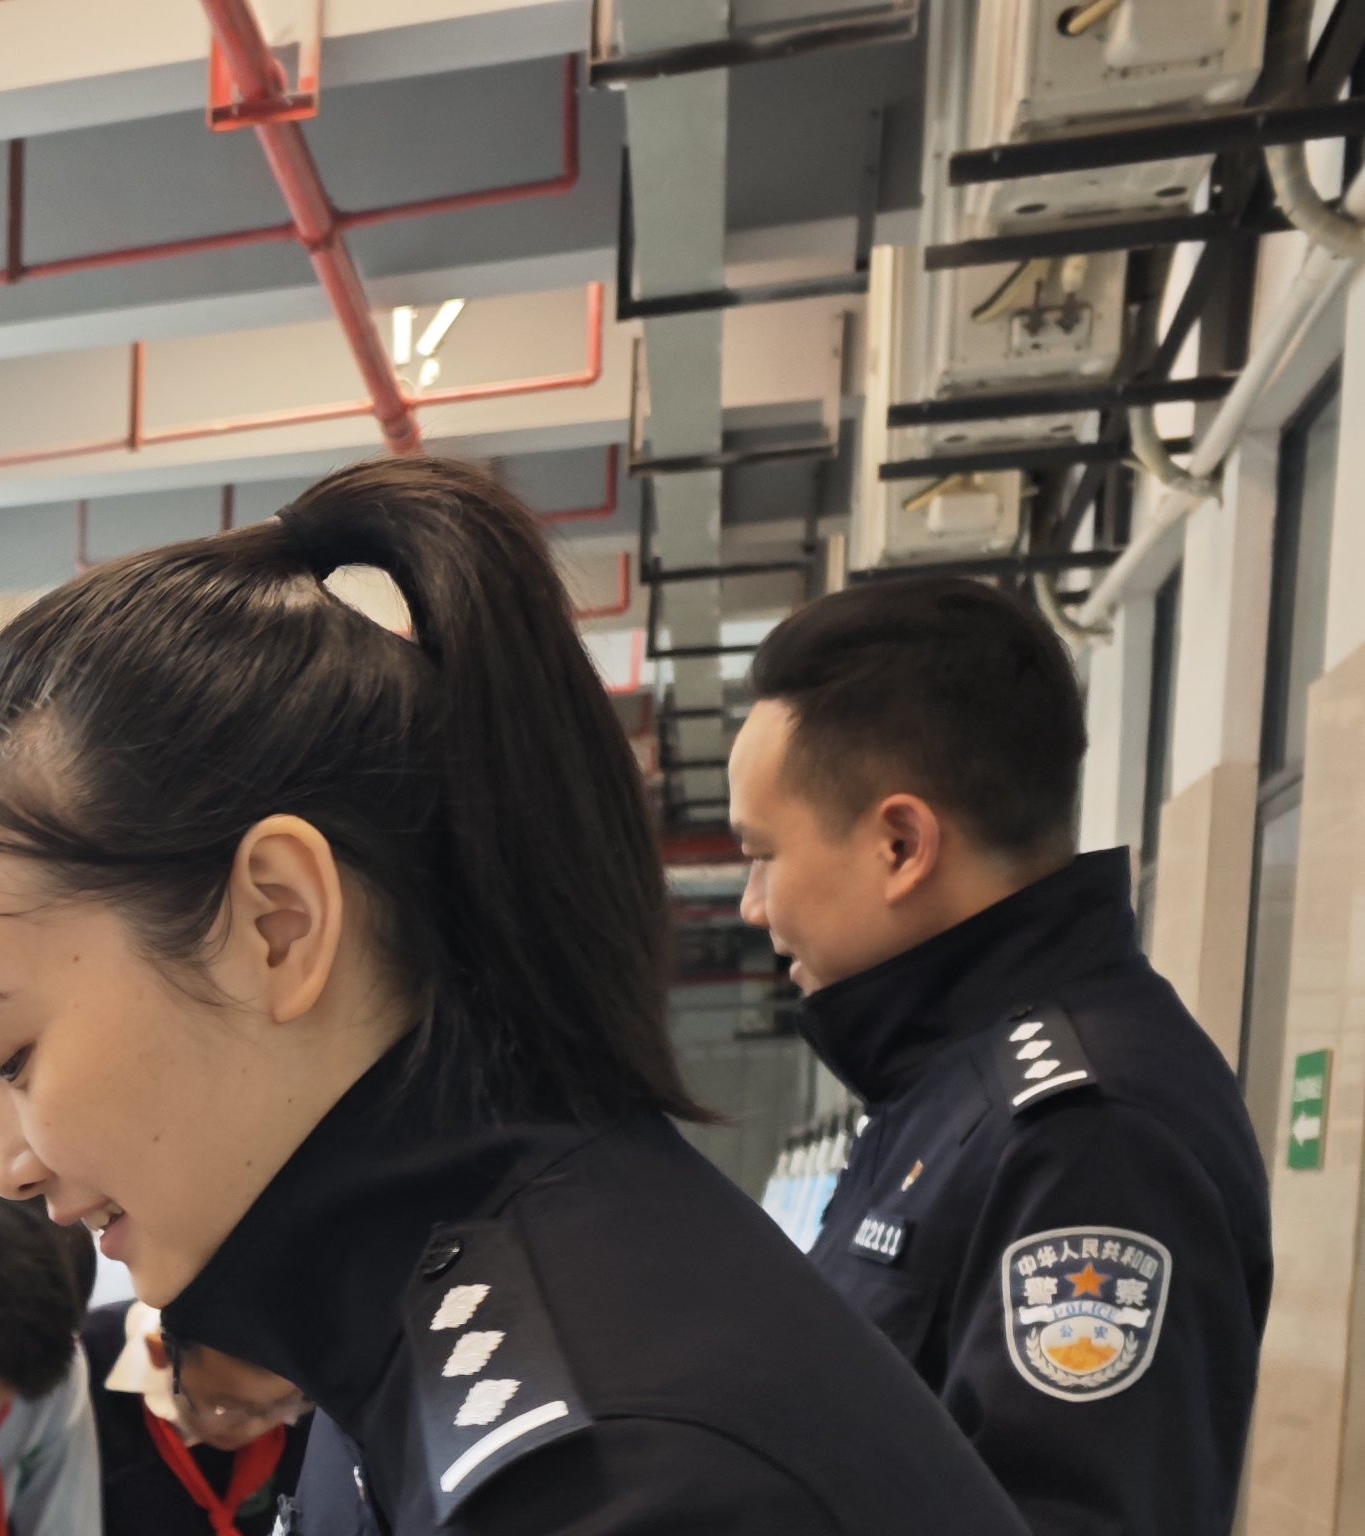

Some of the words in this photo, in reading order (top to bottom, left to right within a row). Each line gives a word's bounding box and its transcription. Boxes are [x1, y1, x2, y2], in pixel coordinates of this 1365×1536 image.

[1017, 1238, 1159, 1280] 中华人民共和国
[1024, 1276, 1148, 1306] 警察
[1053, 1301, 1118, 1322] POLICE
